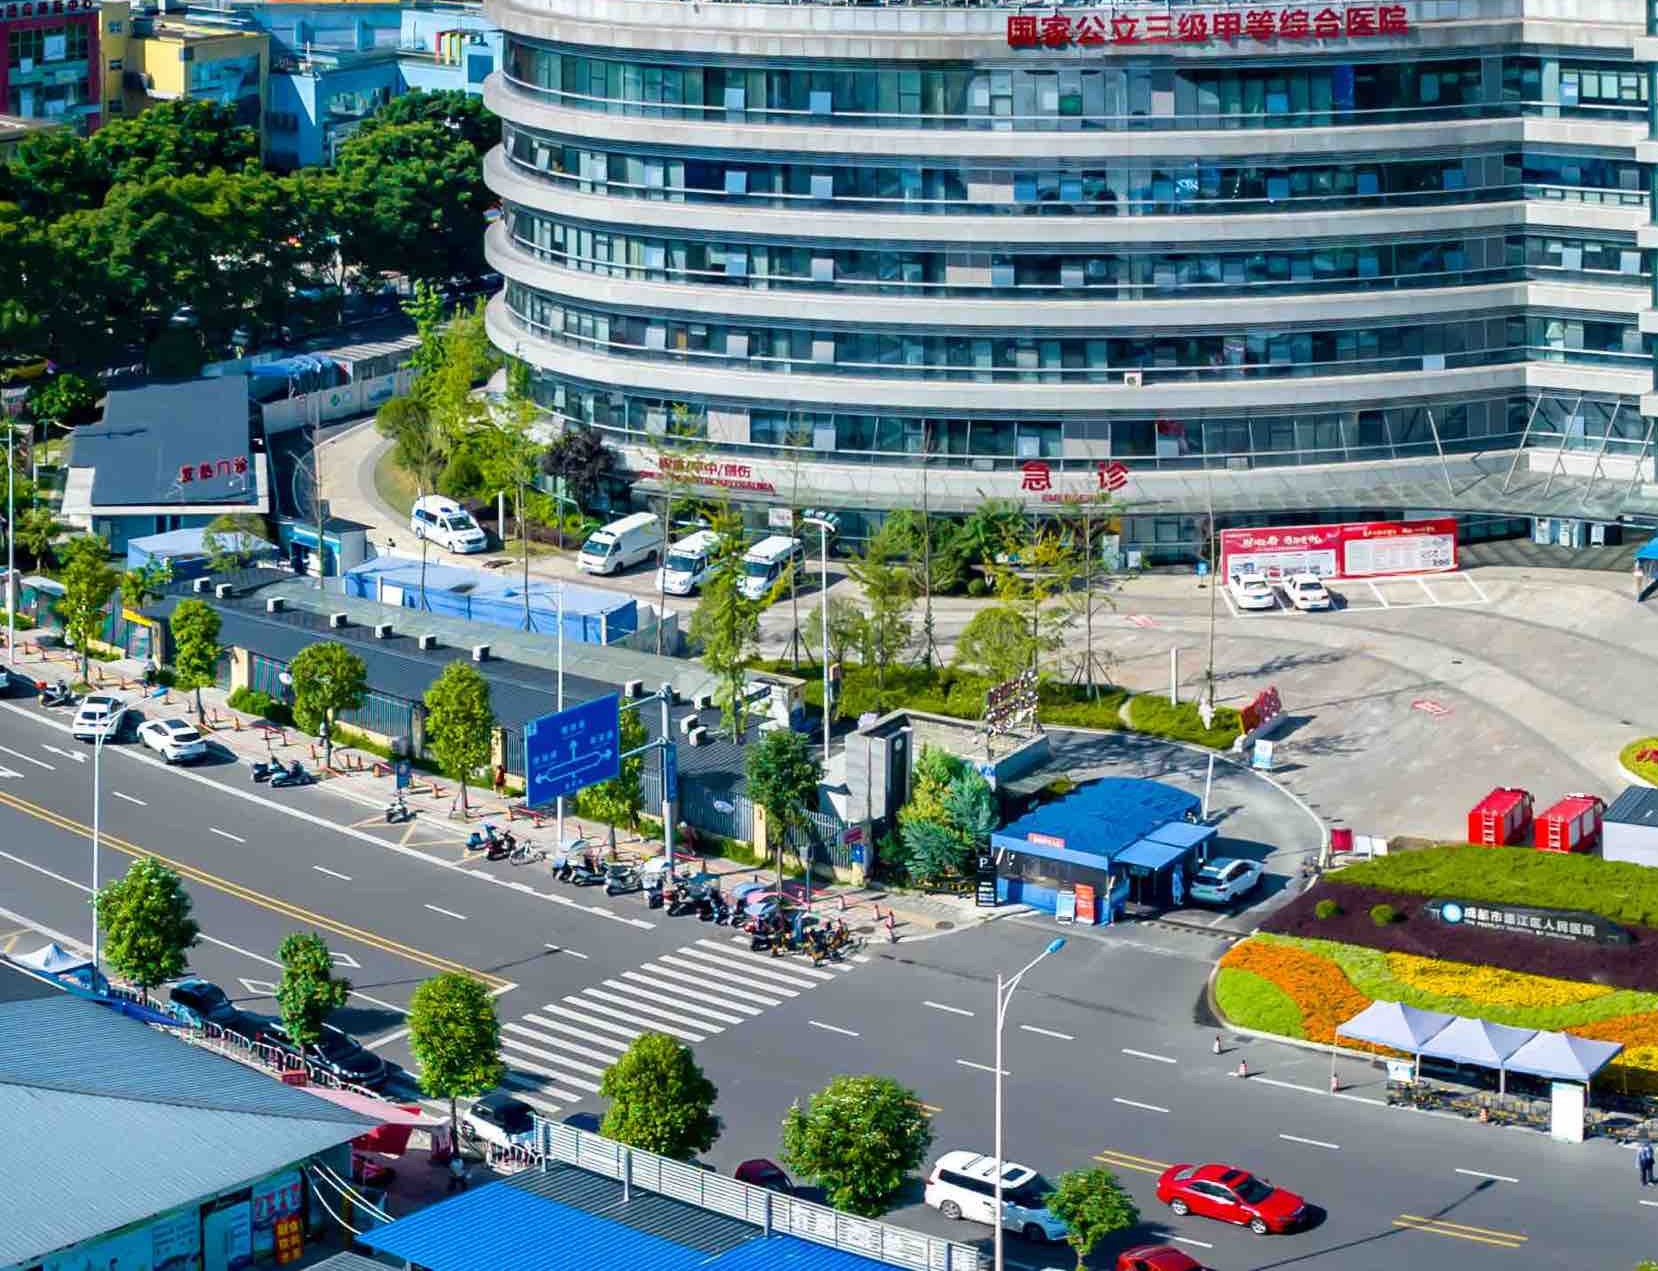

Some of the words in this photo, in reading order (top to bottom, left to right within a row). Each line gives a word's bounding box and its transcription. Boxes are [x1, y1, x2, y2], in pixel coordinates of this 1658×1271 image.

[1007, 5, 1408, 47] 国家公立三级甲等综合医院
[1022, 460, 1129, 492] 急诊
